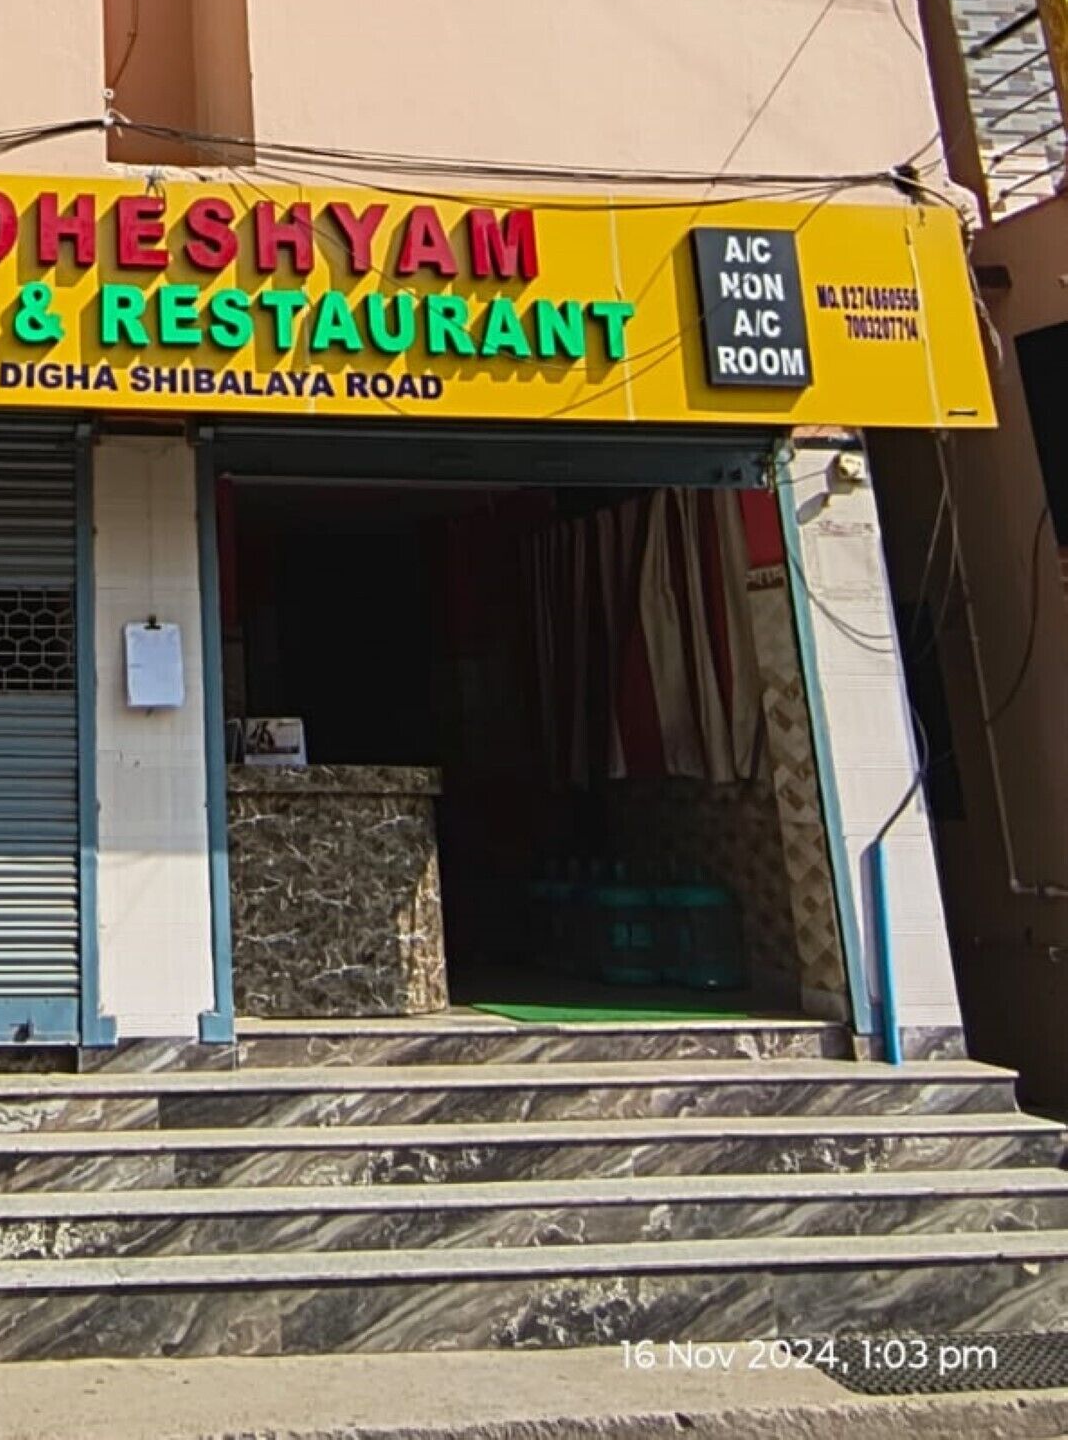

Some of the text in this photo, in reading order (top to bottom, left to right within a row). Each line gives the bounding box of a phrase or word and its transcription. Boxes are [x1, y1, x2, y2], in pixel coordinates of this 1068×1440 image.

[725, 236, 772, 264] A/C
[719, 271, 785, 302] NON
[14, 280, 65, 344] &
[100, 283, 635, 360] RESTAURANT
[733, 309, 782, 338] A/C
[717, 345, 806, 376] ROOM
[129, 366, 335, 398] SHIBALAYA
[346, 373, 443, 400] ROAD
